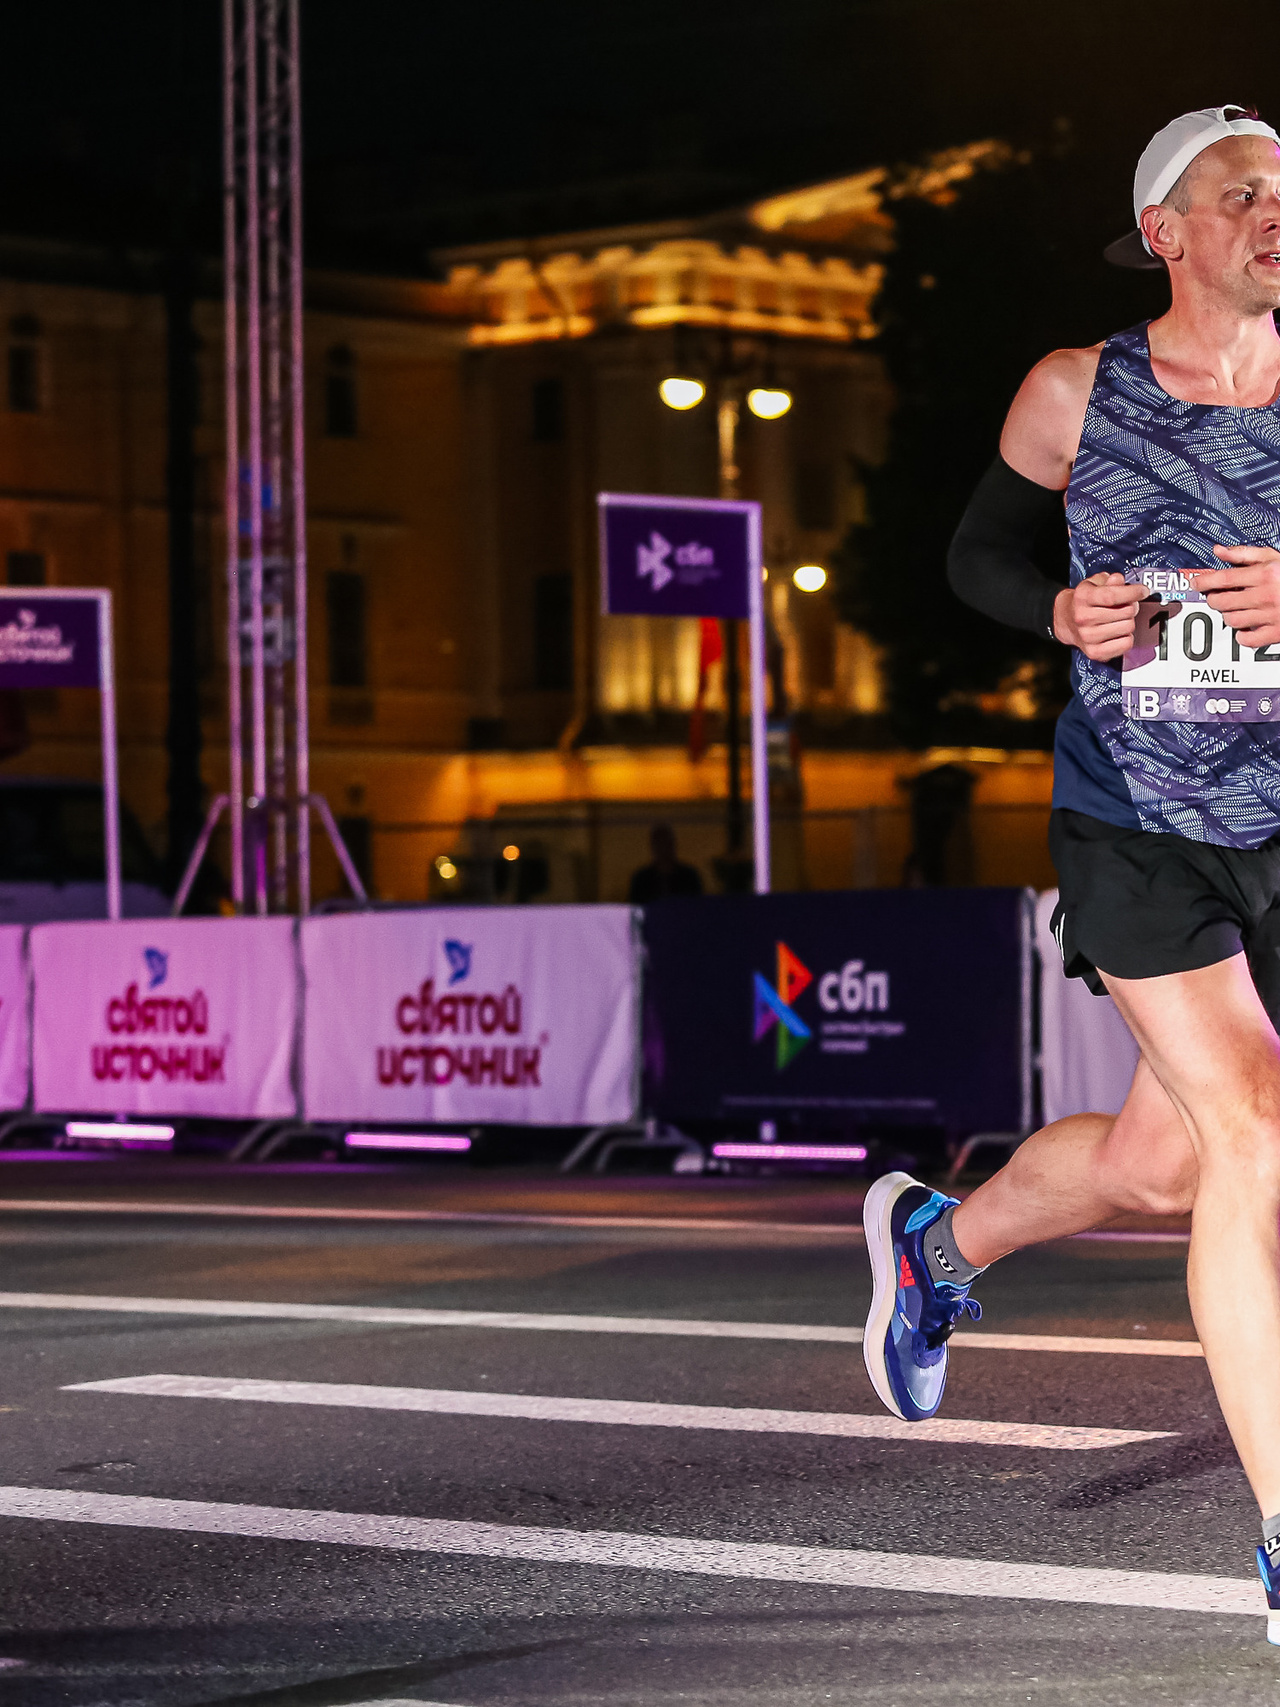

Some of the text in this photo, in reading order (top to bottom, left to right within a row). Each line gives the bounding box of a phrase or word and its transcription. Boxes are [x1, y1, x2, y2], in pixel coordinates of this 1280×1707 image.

[1143, 571, 1200, 591] БЕЛЫ
[1190, 669, 1240, 683] PAVEL
[818, 959, 889, 1013] сбп
